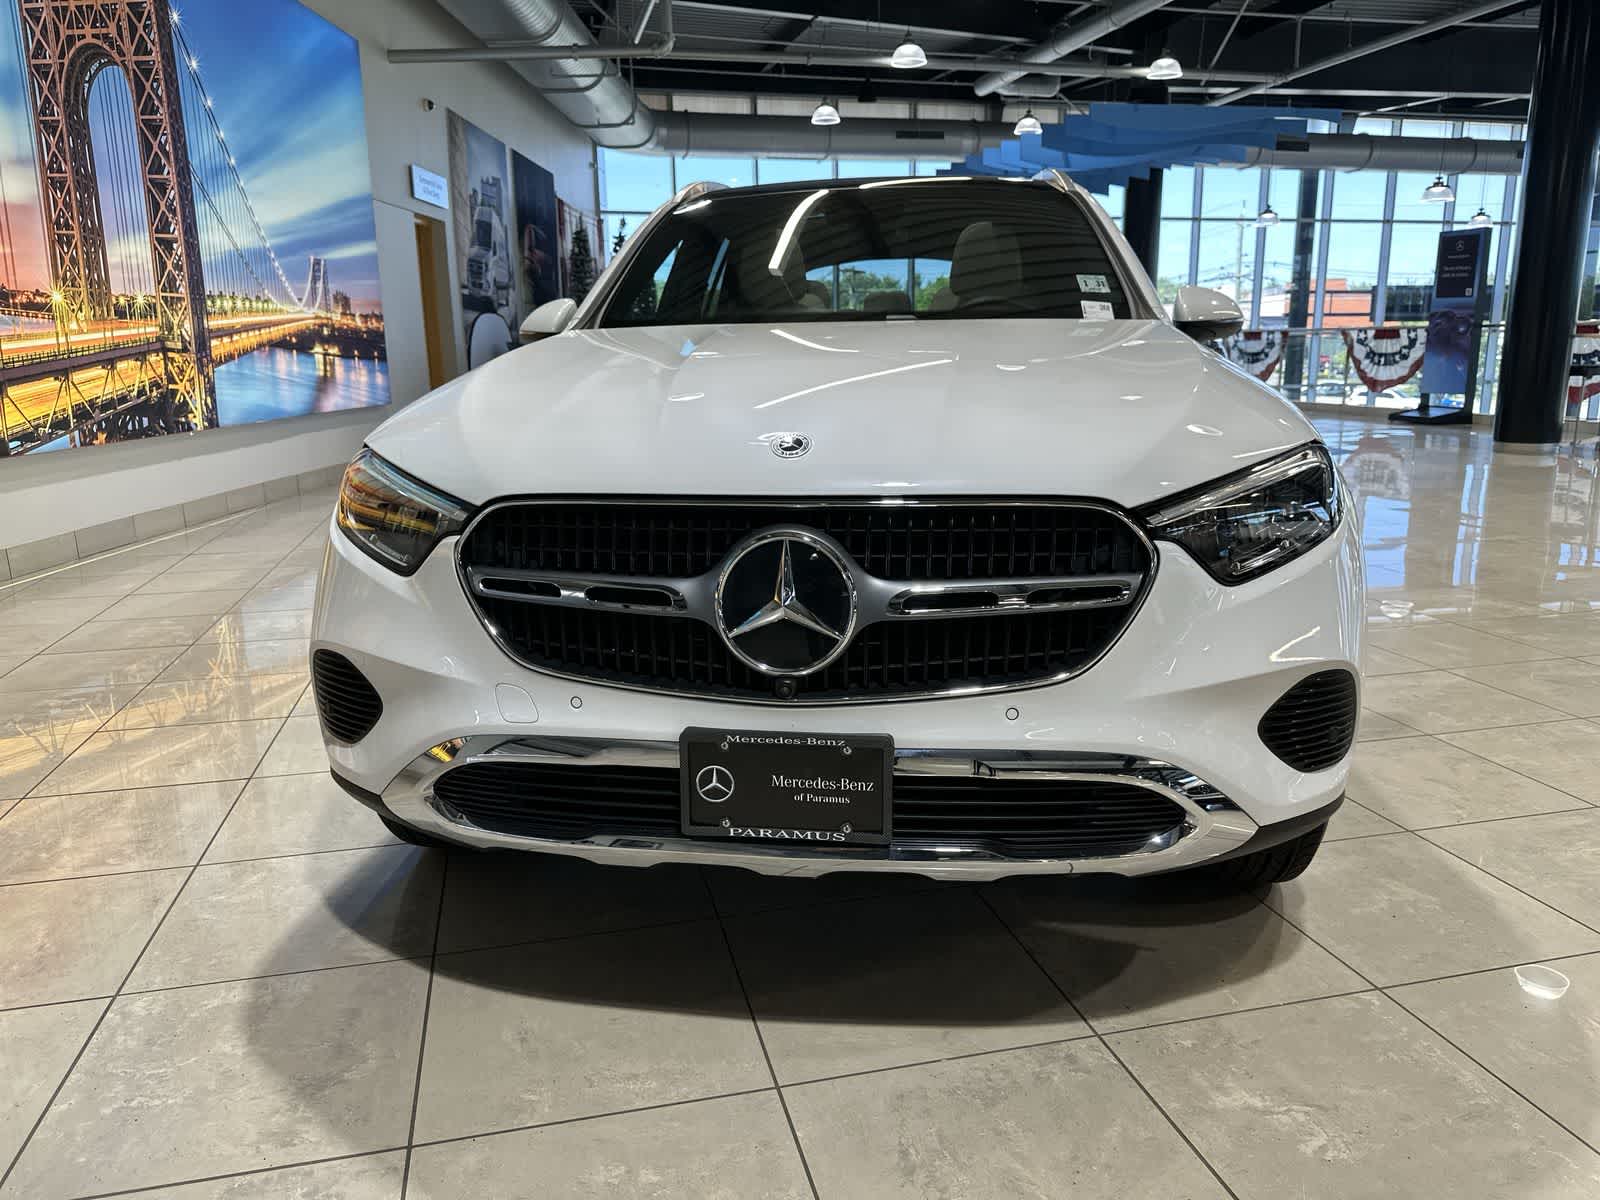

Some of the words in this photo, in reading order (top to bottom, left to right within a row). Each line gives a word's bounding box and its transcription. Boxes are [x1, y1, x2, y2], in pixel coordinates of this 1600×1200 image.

[726, 735, 846, 746] Mercedes-Benz
[771, 775, 874, 792] Mercedes-Benz
[794, 793, 804, 801] of
[807, 794, 850, 804] Paramus
[728, 827, 846, 841] PARAMUS
